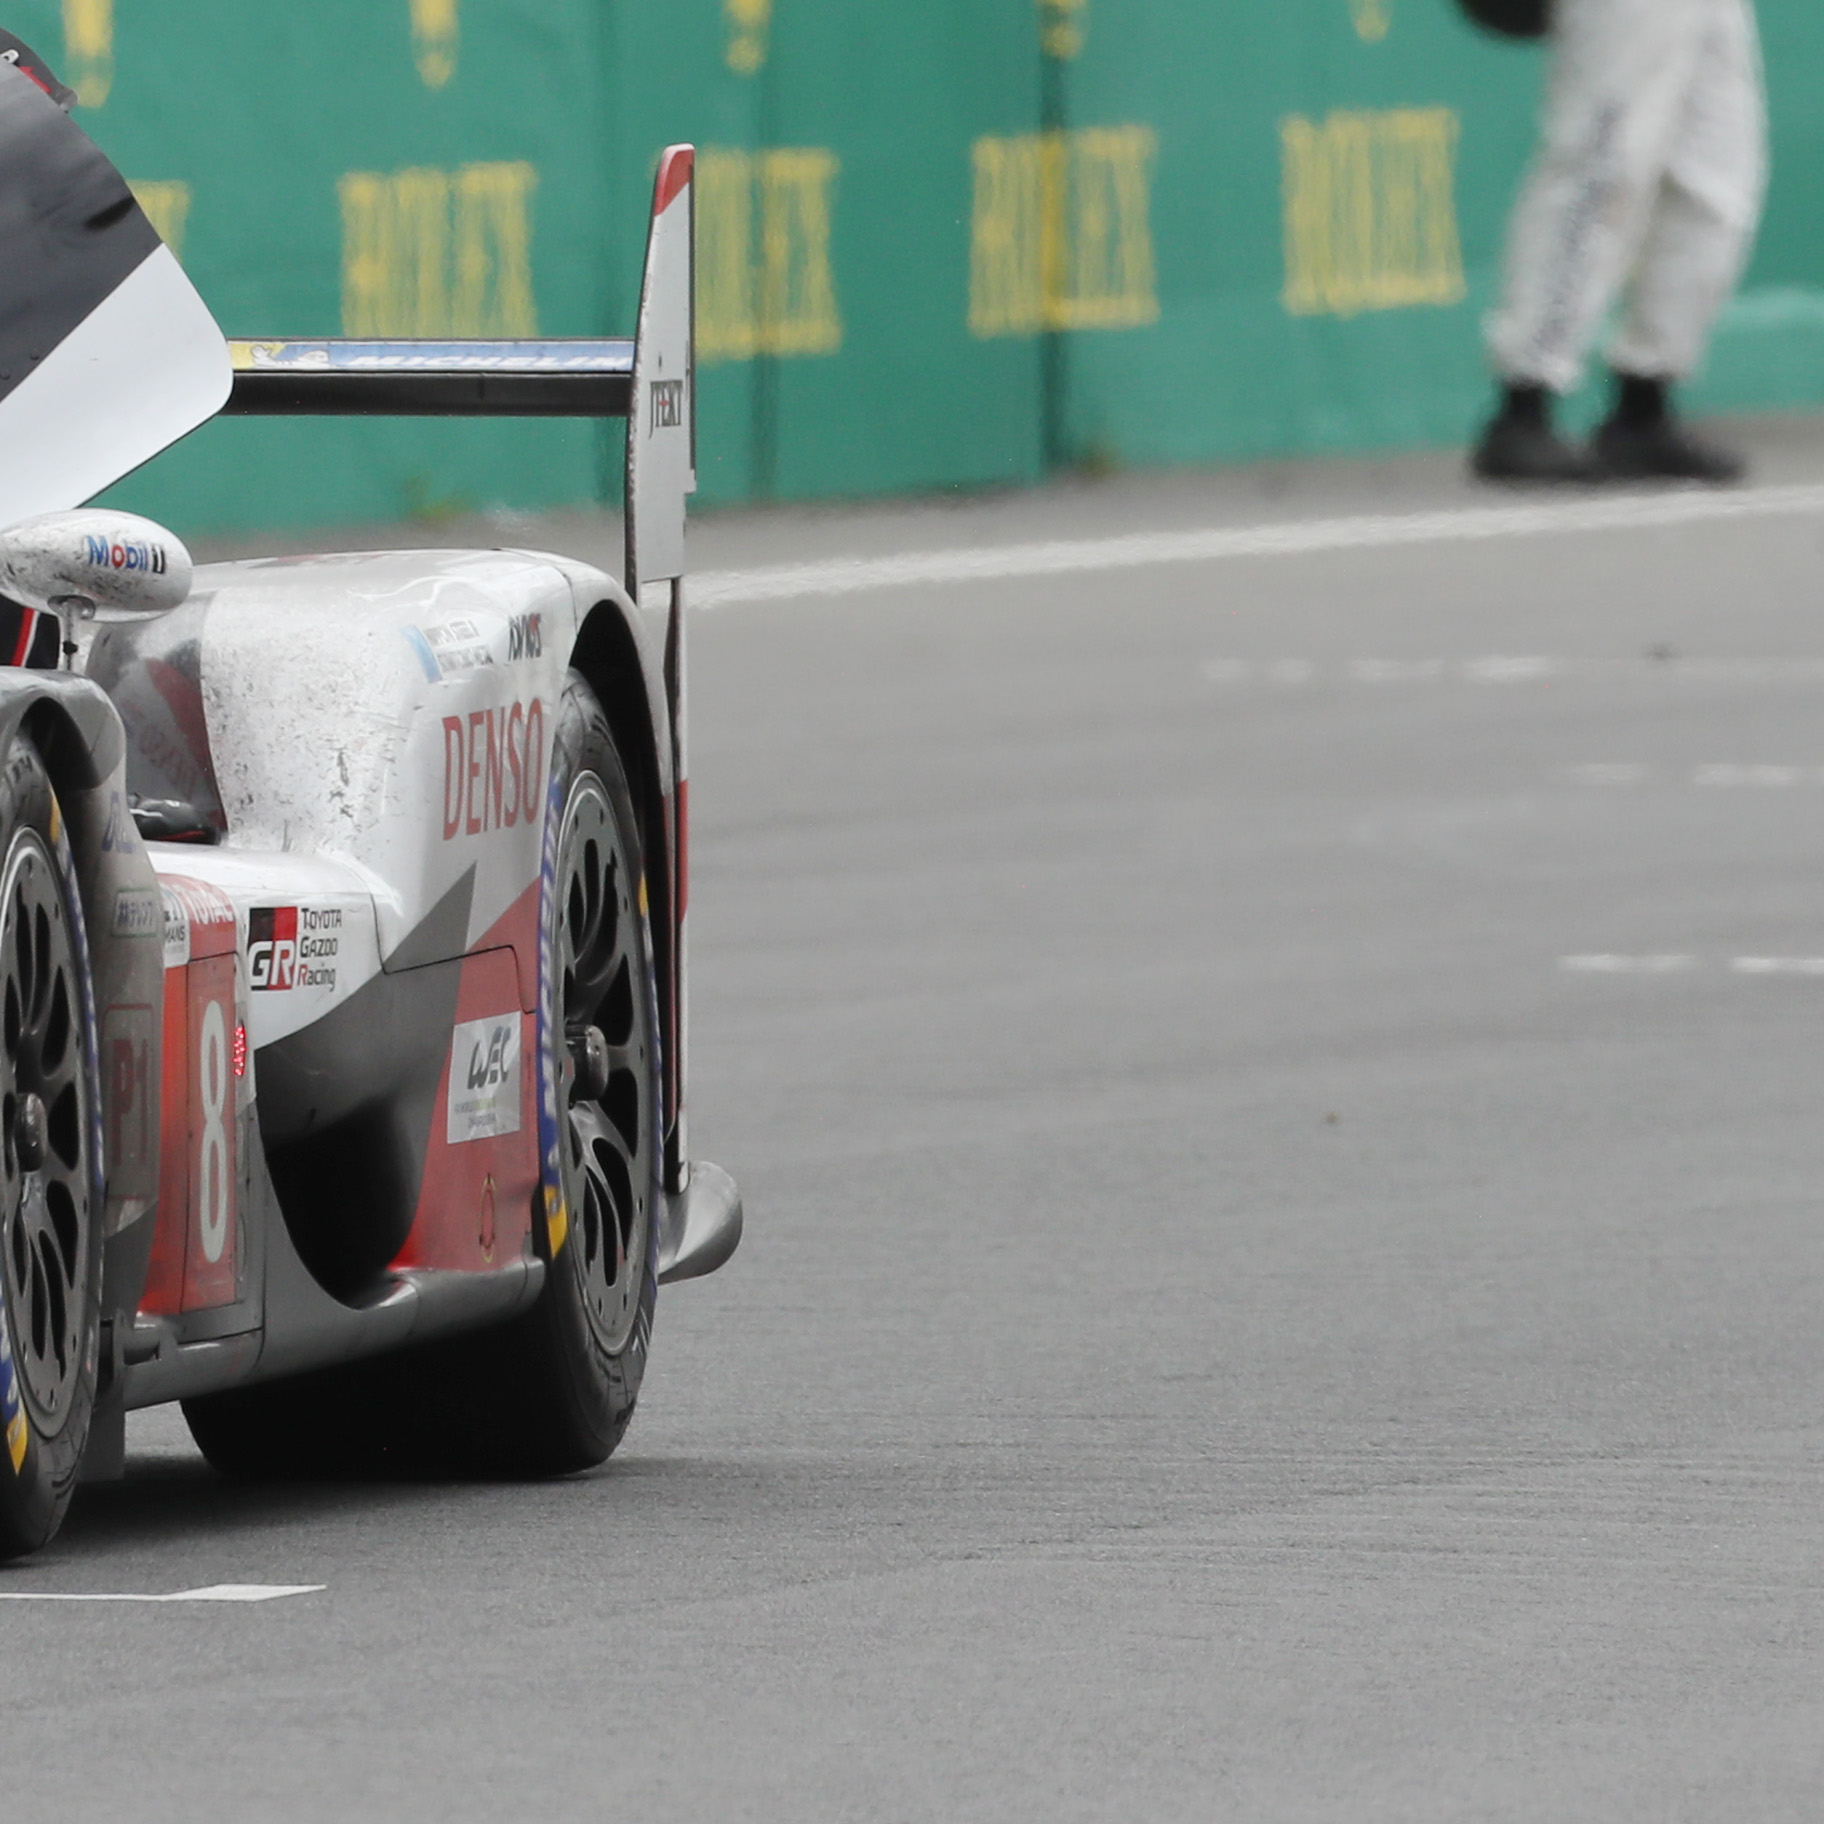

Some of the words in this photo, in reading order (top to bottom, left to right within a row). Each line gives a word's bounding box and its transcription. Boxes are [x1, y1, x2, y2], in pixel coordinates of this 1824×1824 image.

[87, 535, 149, 571] Mobil
[441, 696, 544, 841] DENSO
[300, 907, 342, 930] TOYOTA
[248, 939, 297, 991] GR
[299, 936, 338, 958] GAZOO
[297, 963, 336, 992] Racing
[466, 1025, 512, 1090] WEC
[199, 1000, 227, 1264] 8
